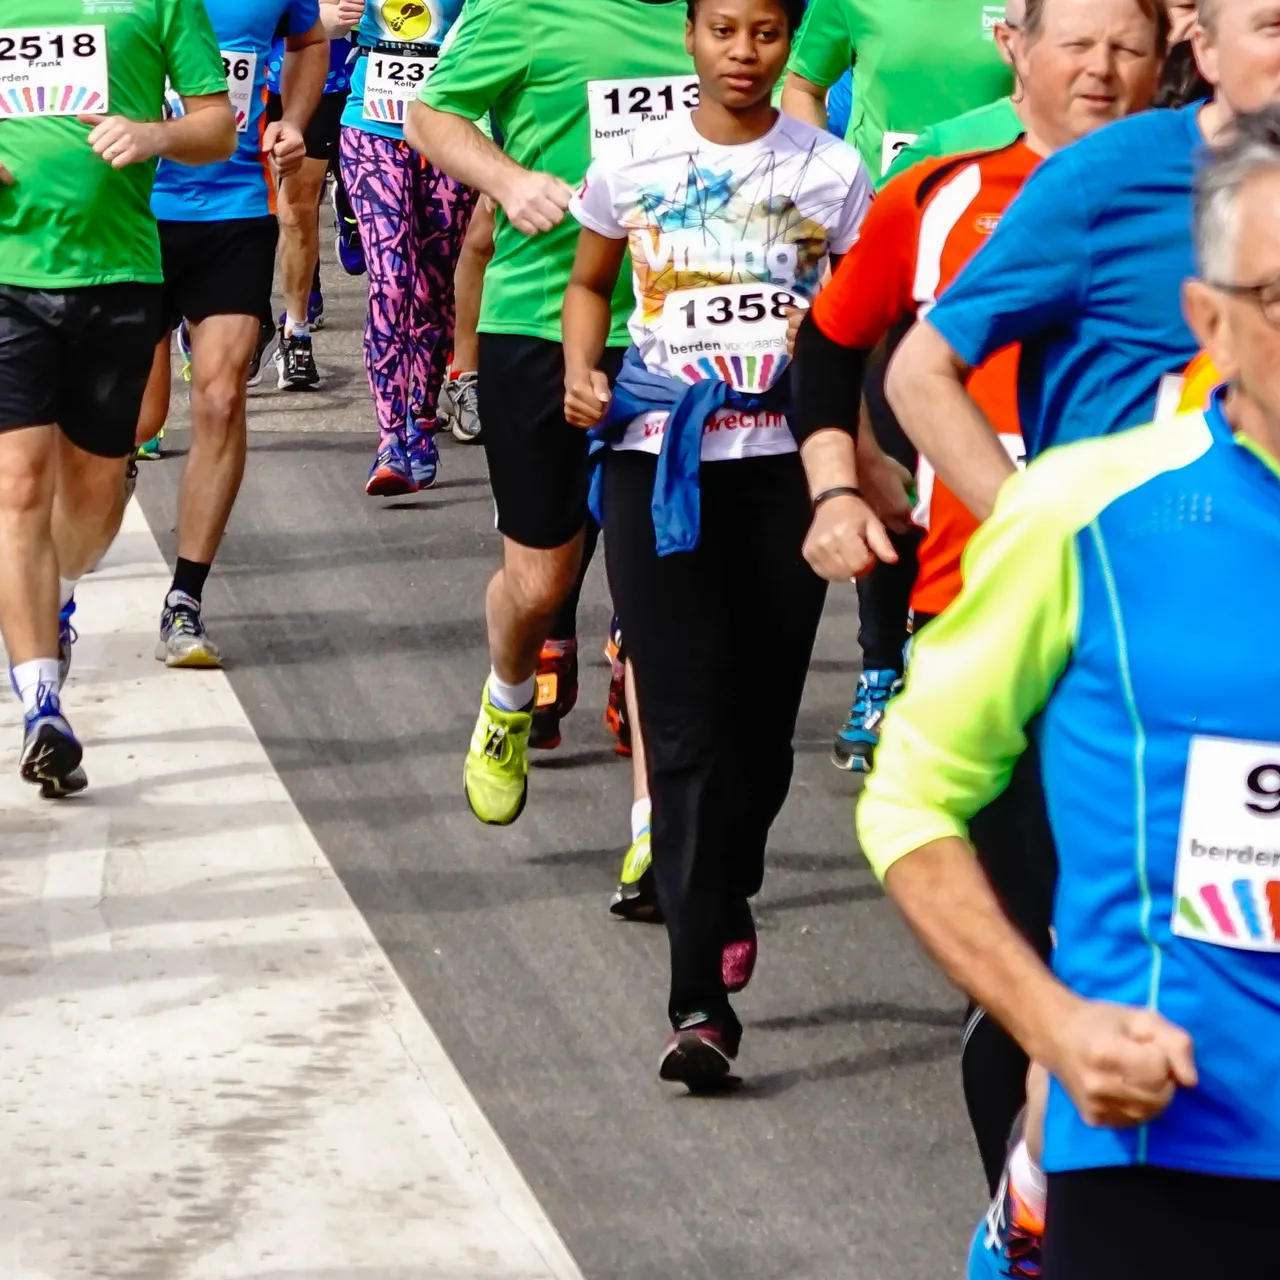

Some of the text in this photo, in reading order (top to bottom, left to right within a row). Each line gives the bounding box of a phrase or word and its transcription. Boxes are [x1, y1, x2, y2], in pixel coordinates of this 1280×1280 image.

[28, 60, 62, 68] Frank
[394, 80, 417, 89] Kelly
[603, 82, 701, 115] 1213
[641, 112, 668, 122] Paul
[679, 291, 797, 329] 1358
[669, 340, 722, 355] berden
